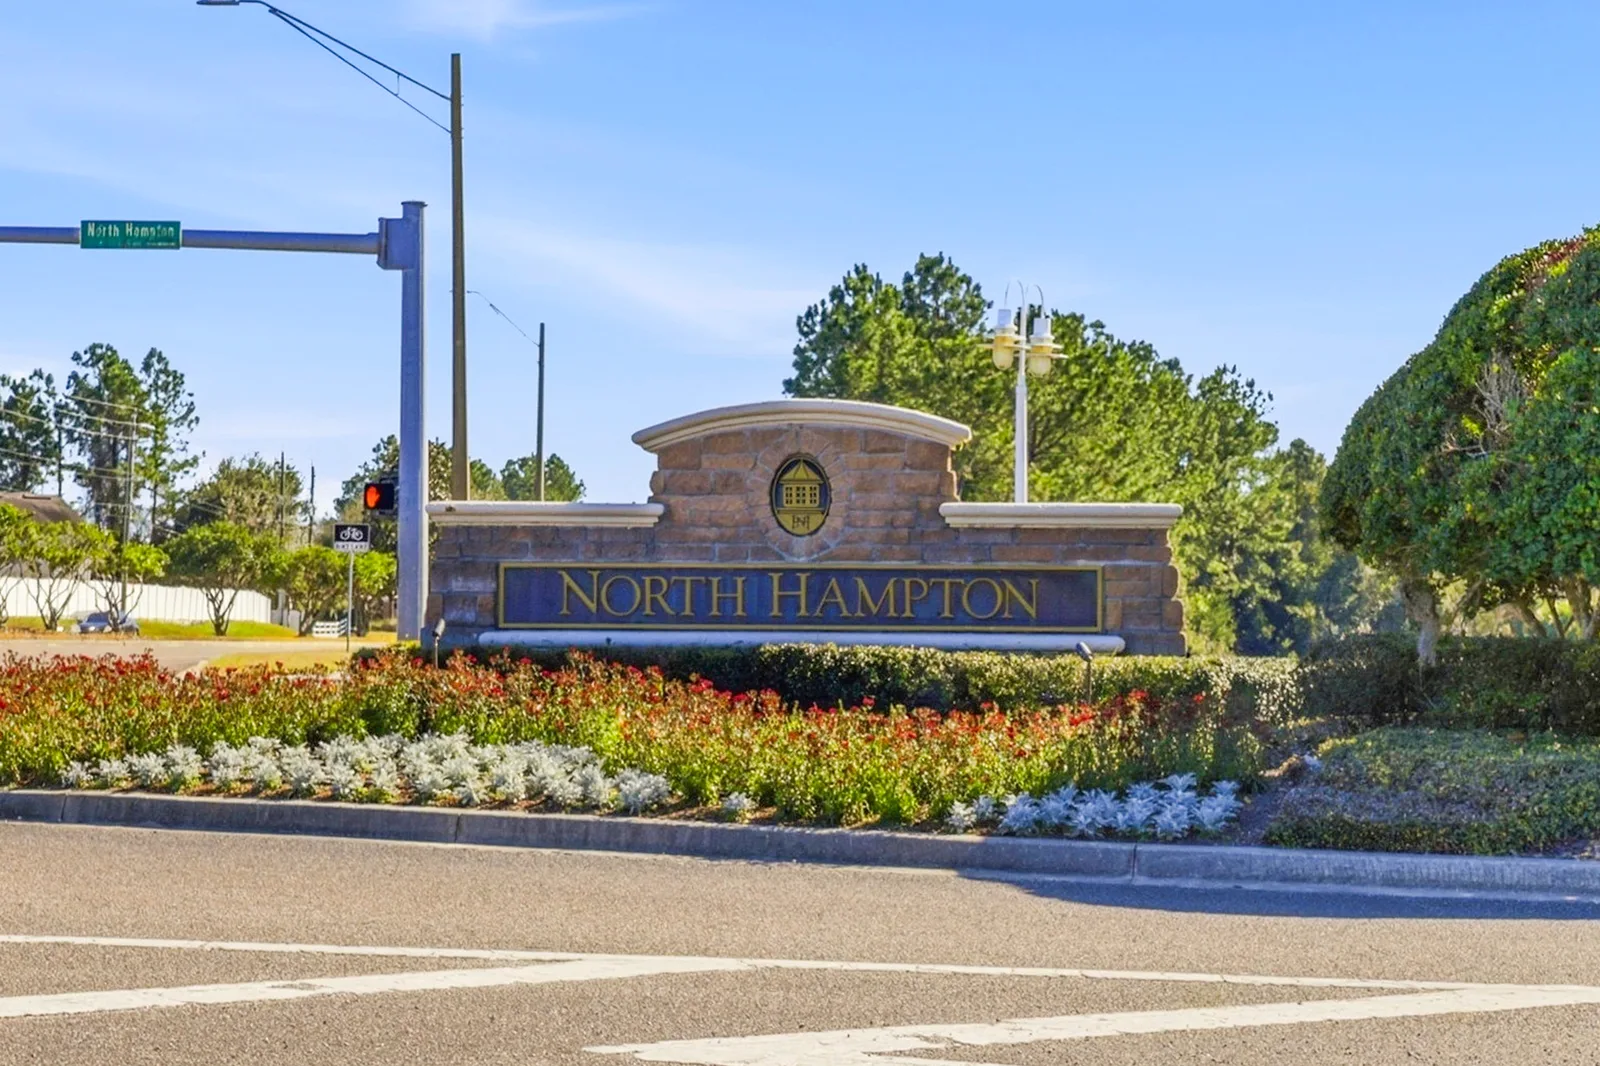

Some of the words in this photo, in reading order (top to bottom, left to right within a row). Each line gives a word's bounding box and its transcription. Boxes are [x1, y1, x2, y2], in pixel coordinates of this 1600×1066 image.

[87, 222, 120, 237] North
[558, 570, 747, 617] NORTH
[768, 572, 1039, 619] HAMPTON
